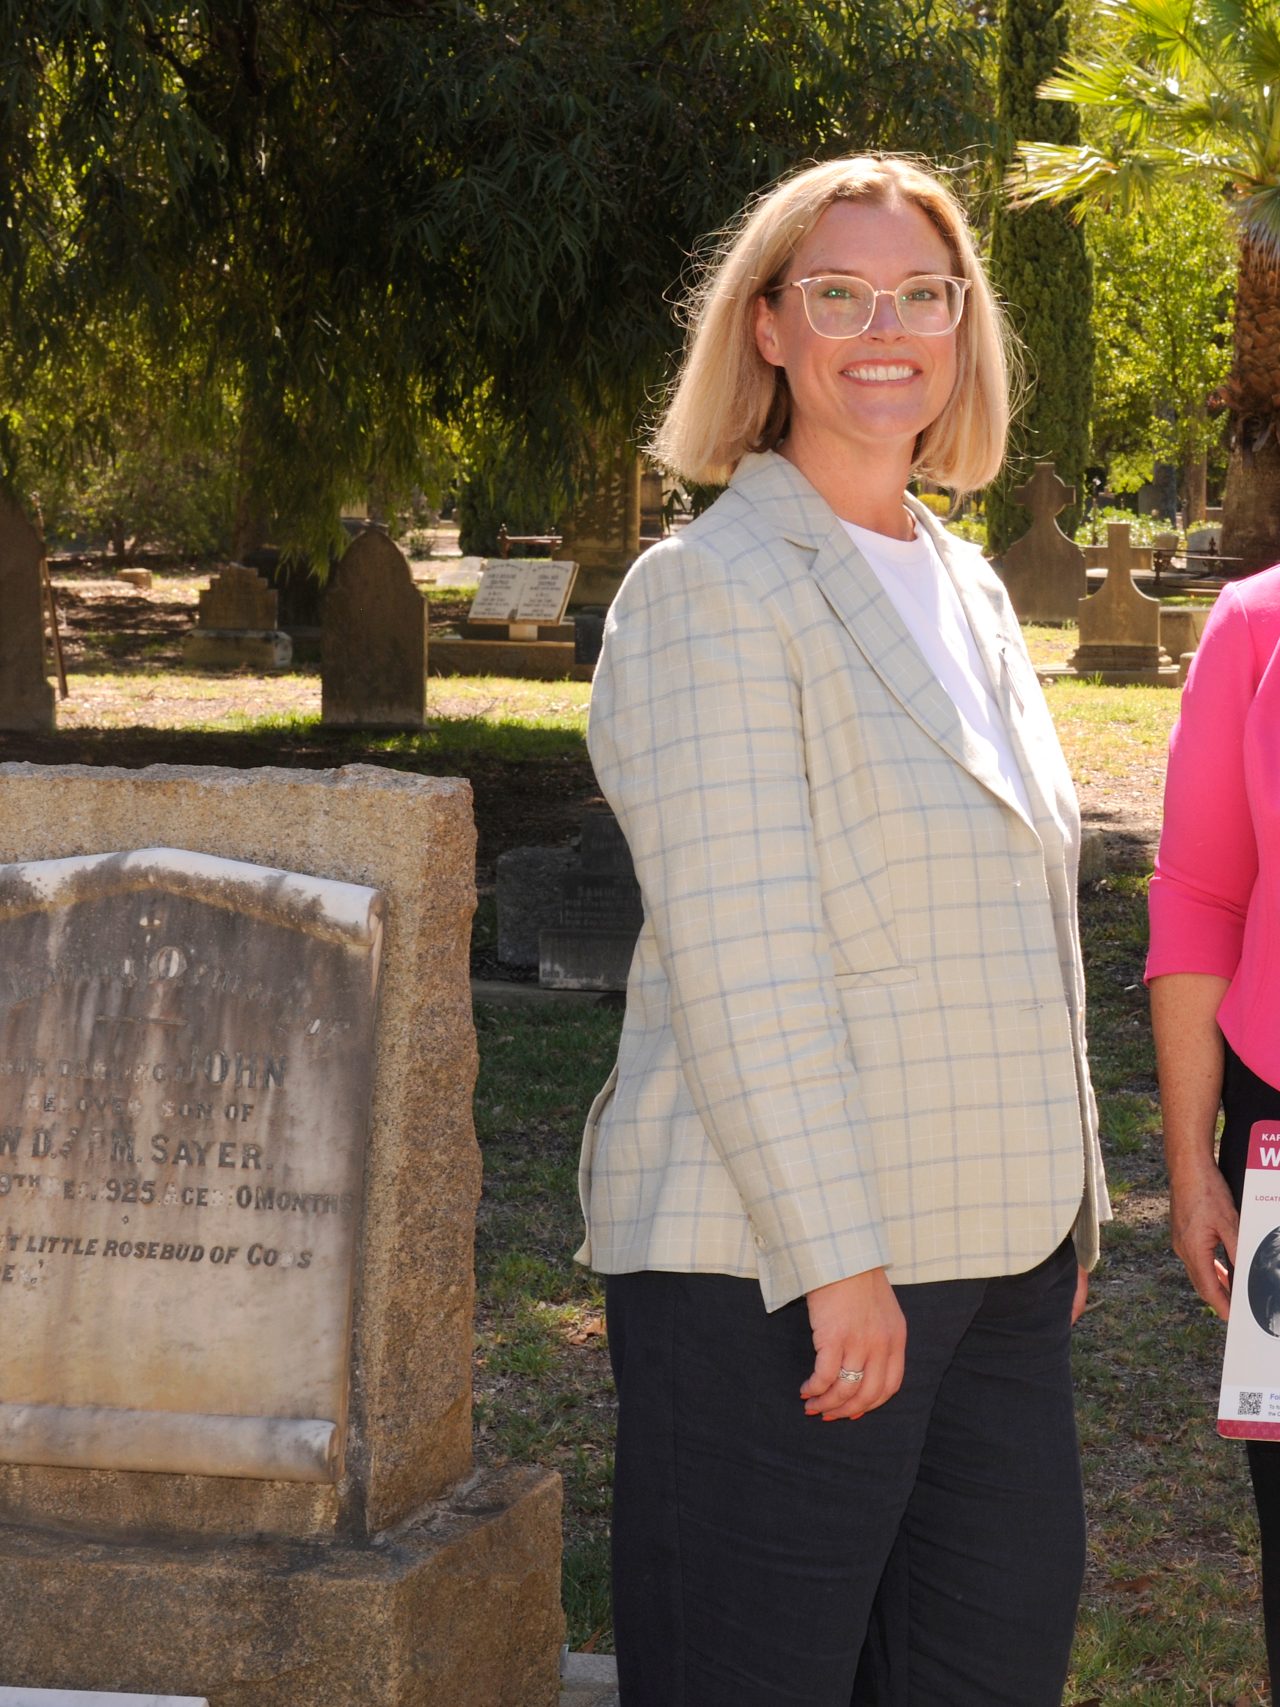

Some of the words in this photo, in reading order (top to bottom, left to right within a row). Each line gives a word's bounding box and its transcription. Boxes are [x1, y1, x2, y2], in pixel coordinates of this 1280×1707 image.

[26, 1235, 98, 1256] LITTLE
[102, 1239, 204, 1264] ROSEBUD
[209, 1246, 239, 1265] OF
